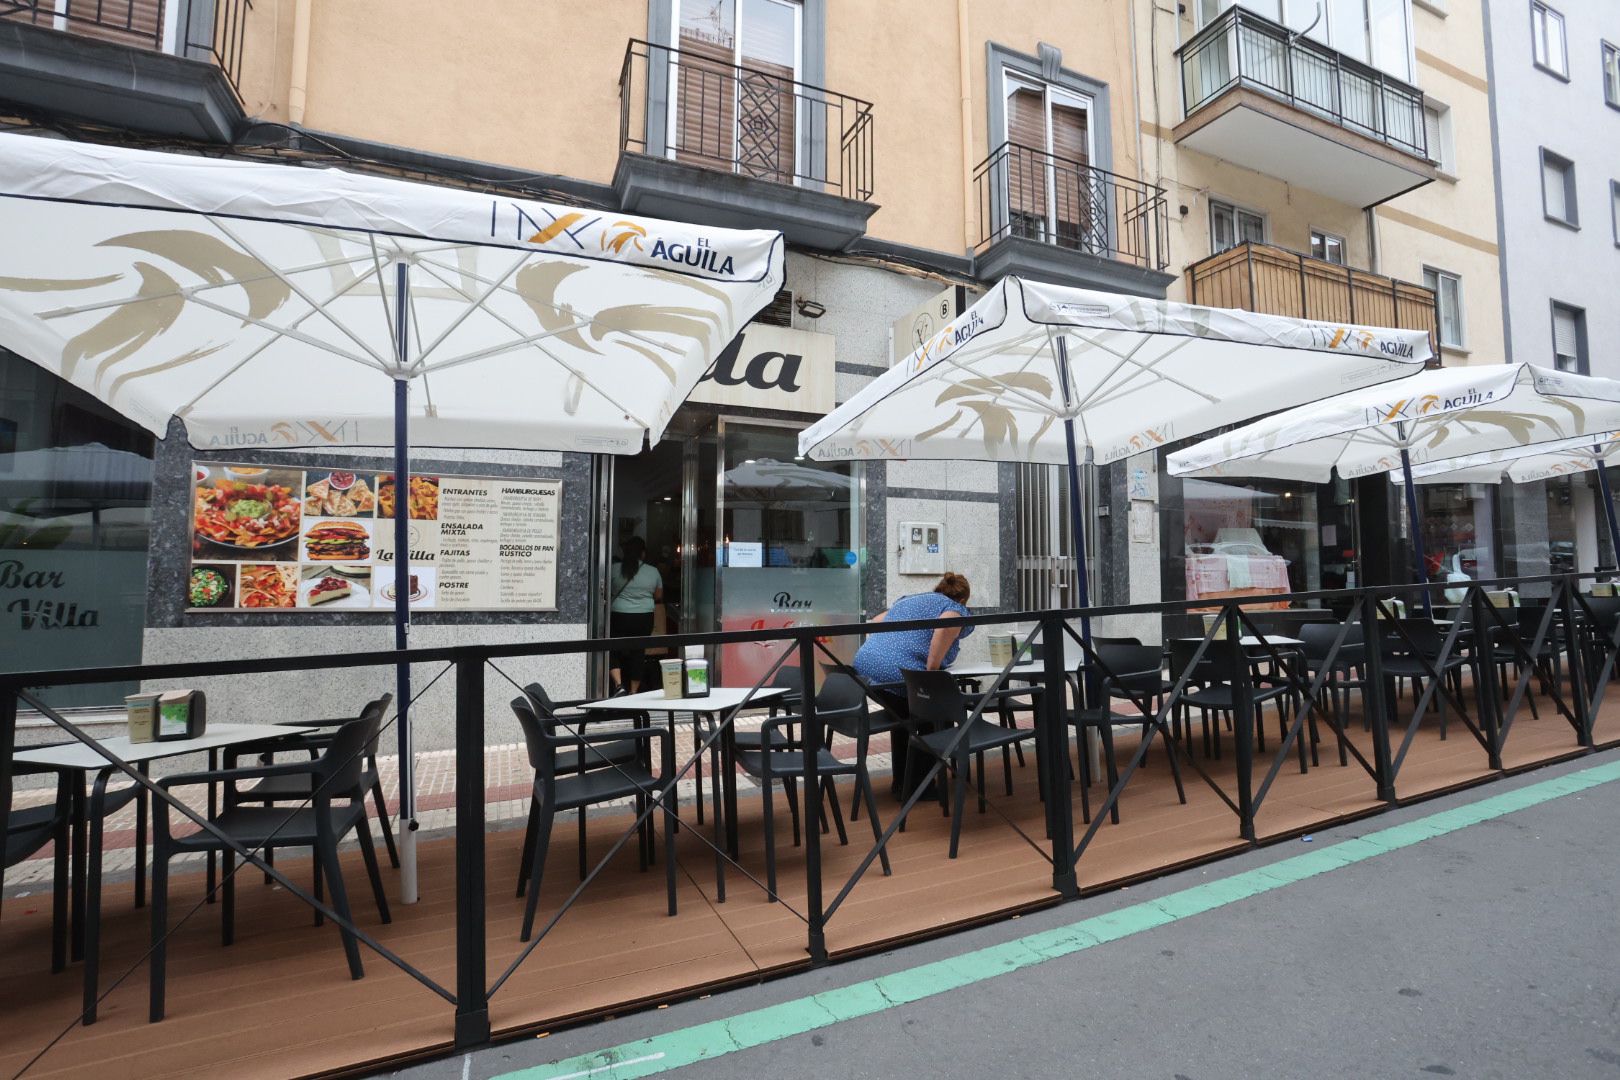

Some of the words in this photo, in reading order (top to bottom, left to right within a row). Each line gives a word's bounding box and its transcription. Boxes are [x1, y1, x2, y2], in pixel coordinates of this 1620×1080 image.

[697, 237, 711, 249] EL
[698, 333, 803, 393] la
[442, 488, 488, 496] ENTRANTES
[501, 487, 556, 496] HAMBURGUESAS
[441, 522, 484, 530] ENSALADA
[376, 549, 394, 561] La
[409, 549, 436, 561] illa
[439, 549, 471, 557] FAJITAS
[0, 560, 66, 589] Bar
[7, 598, 100, 631] Villa
